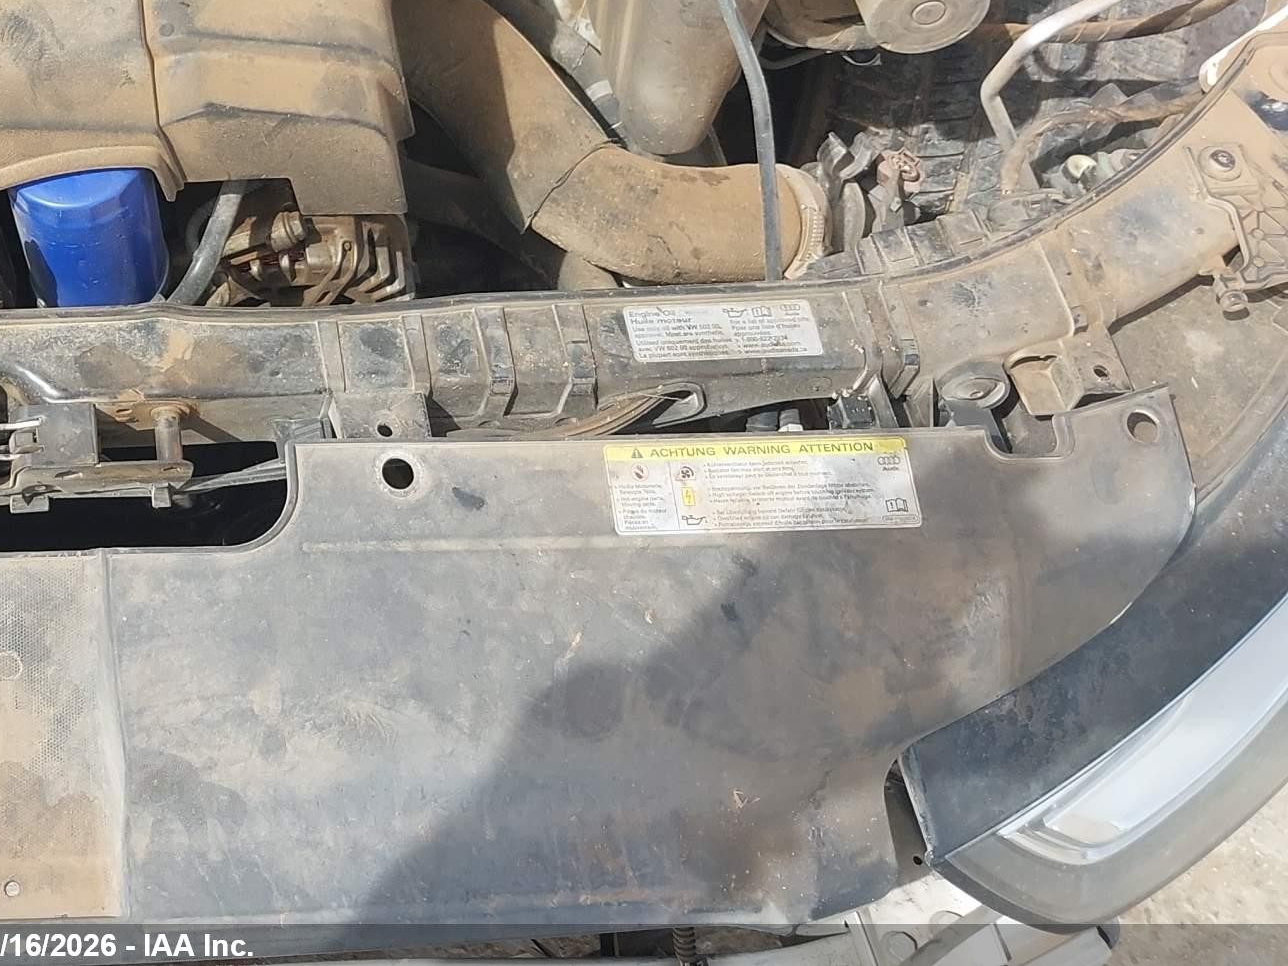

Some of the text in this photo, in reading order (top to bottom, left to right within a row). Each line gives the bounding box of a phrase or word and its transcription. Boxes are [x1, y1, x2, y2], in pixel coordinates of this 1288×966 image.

[650, 442, 874, 458] ACHTUNG WARNING ATTENTION
